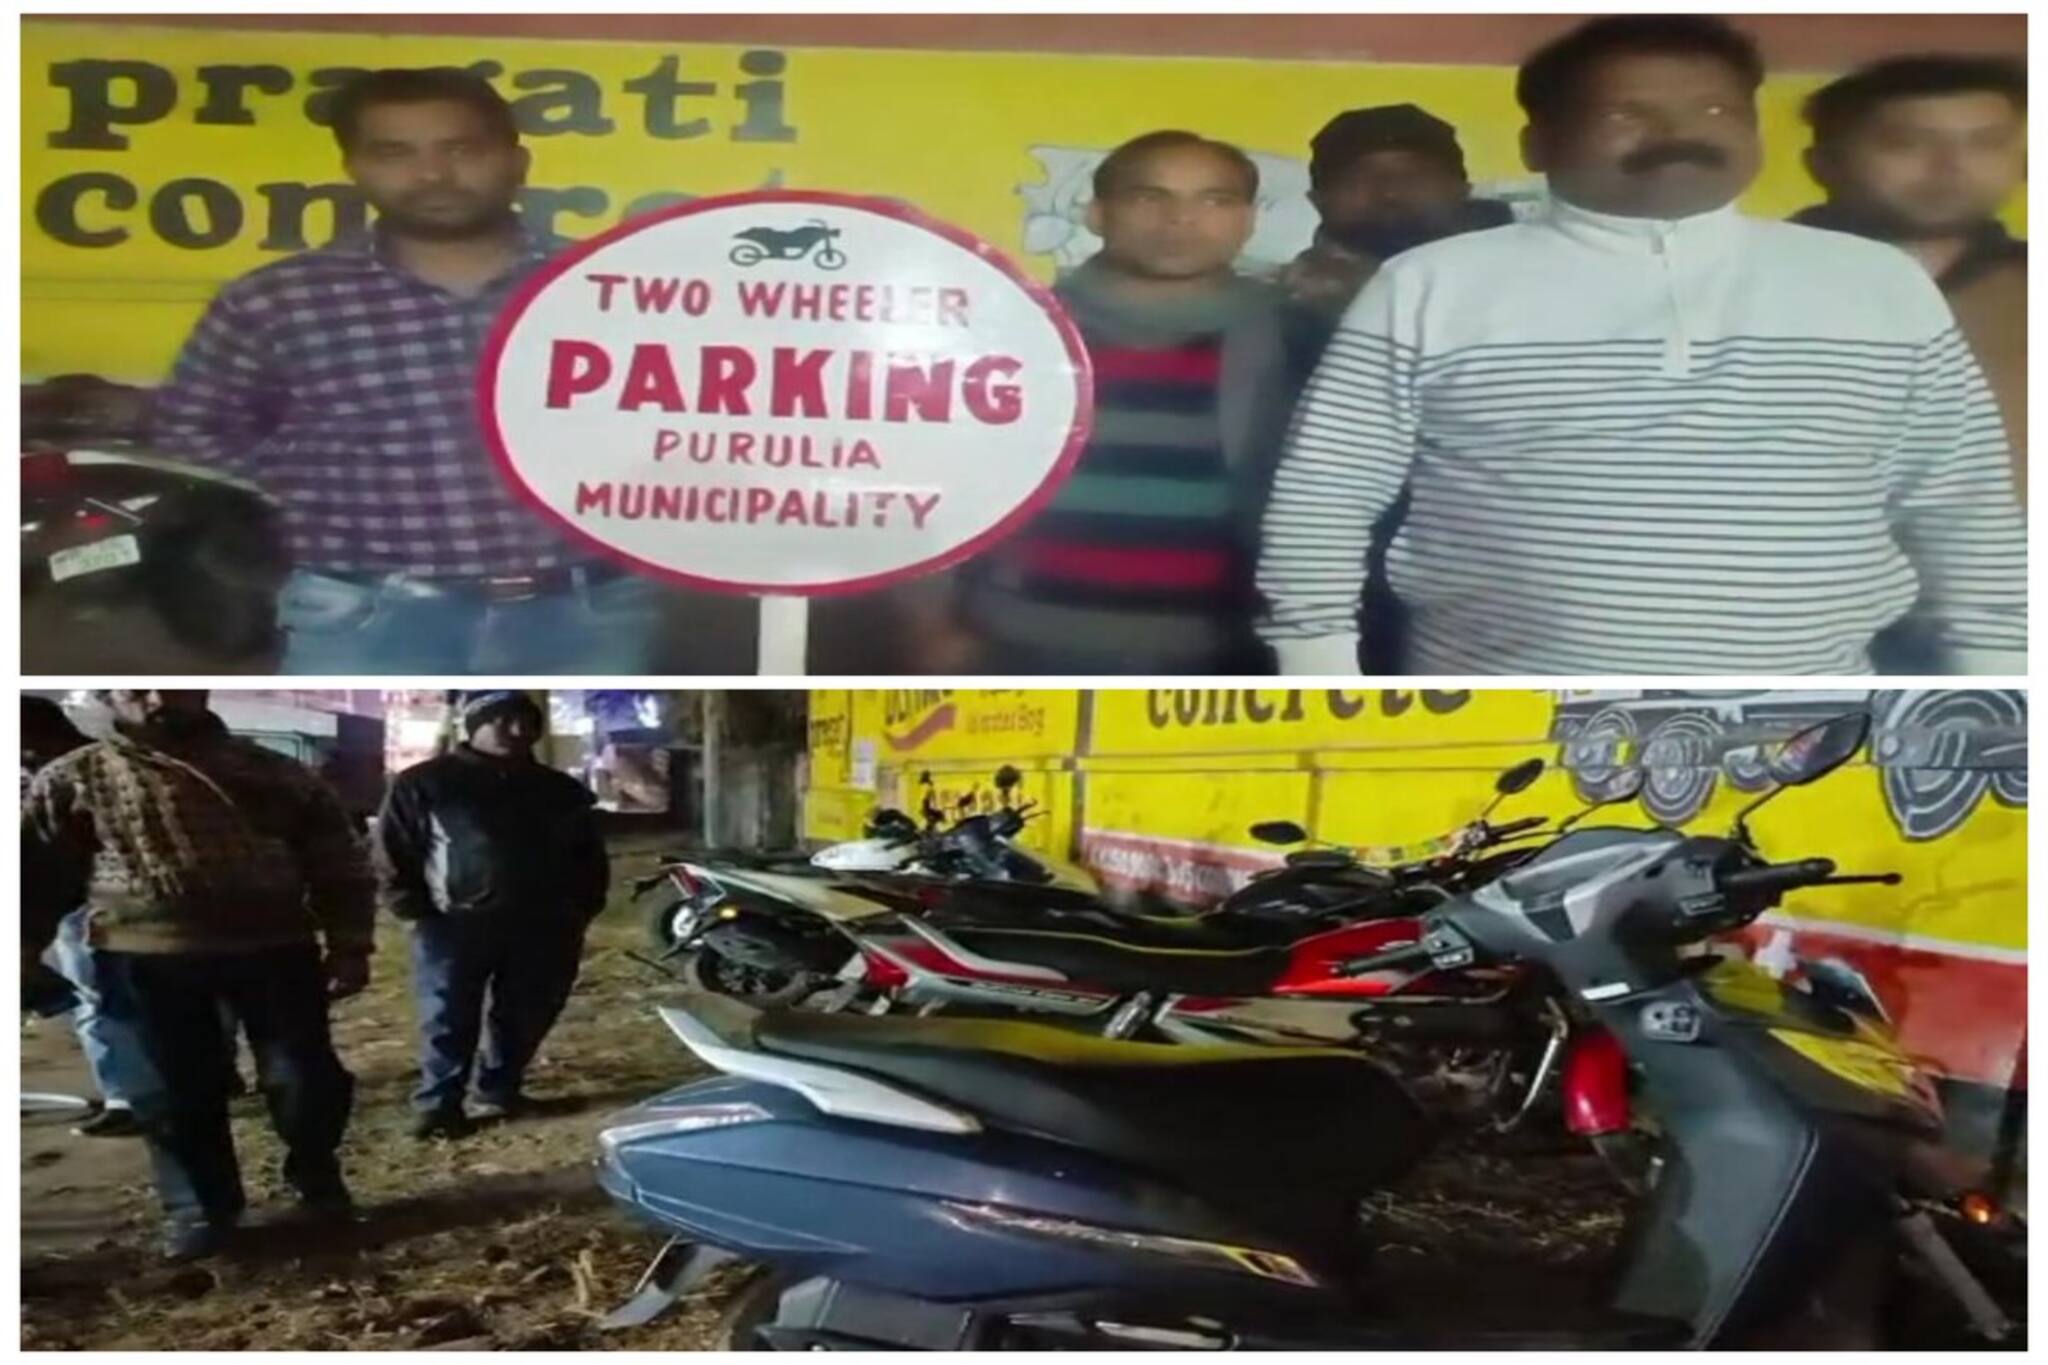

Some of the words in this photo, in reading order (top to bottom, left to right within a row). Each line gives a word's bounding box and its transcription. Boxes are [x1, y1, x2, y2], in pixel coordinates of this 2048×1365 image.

[47, 50, 797, 151] praati
[585, 274, 711, 316] TWO
[738, 281, 970, 328] WHEELER
[545, 339, 1024, 425] PARKING
[575, 481, 941, 530] MUNICIPALITY
